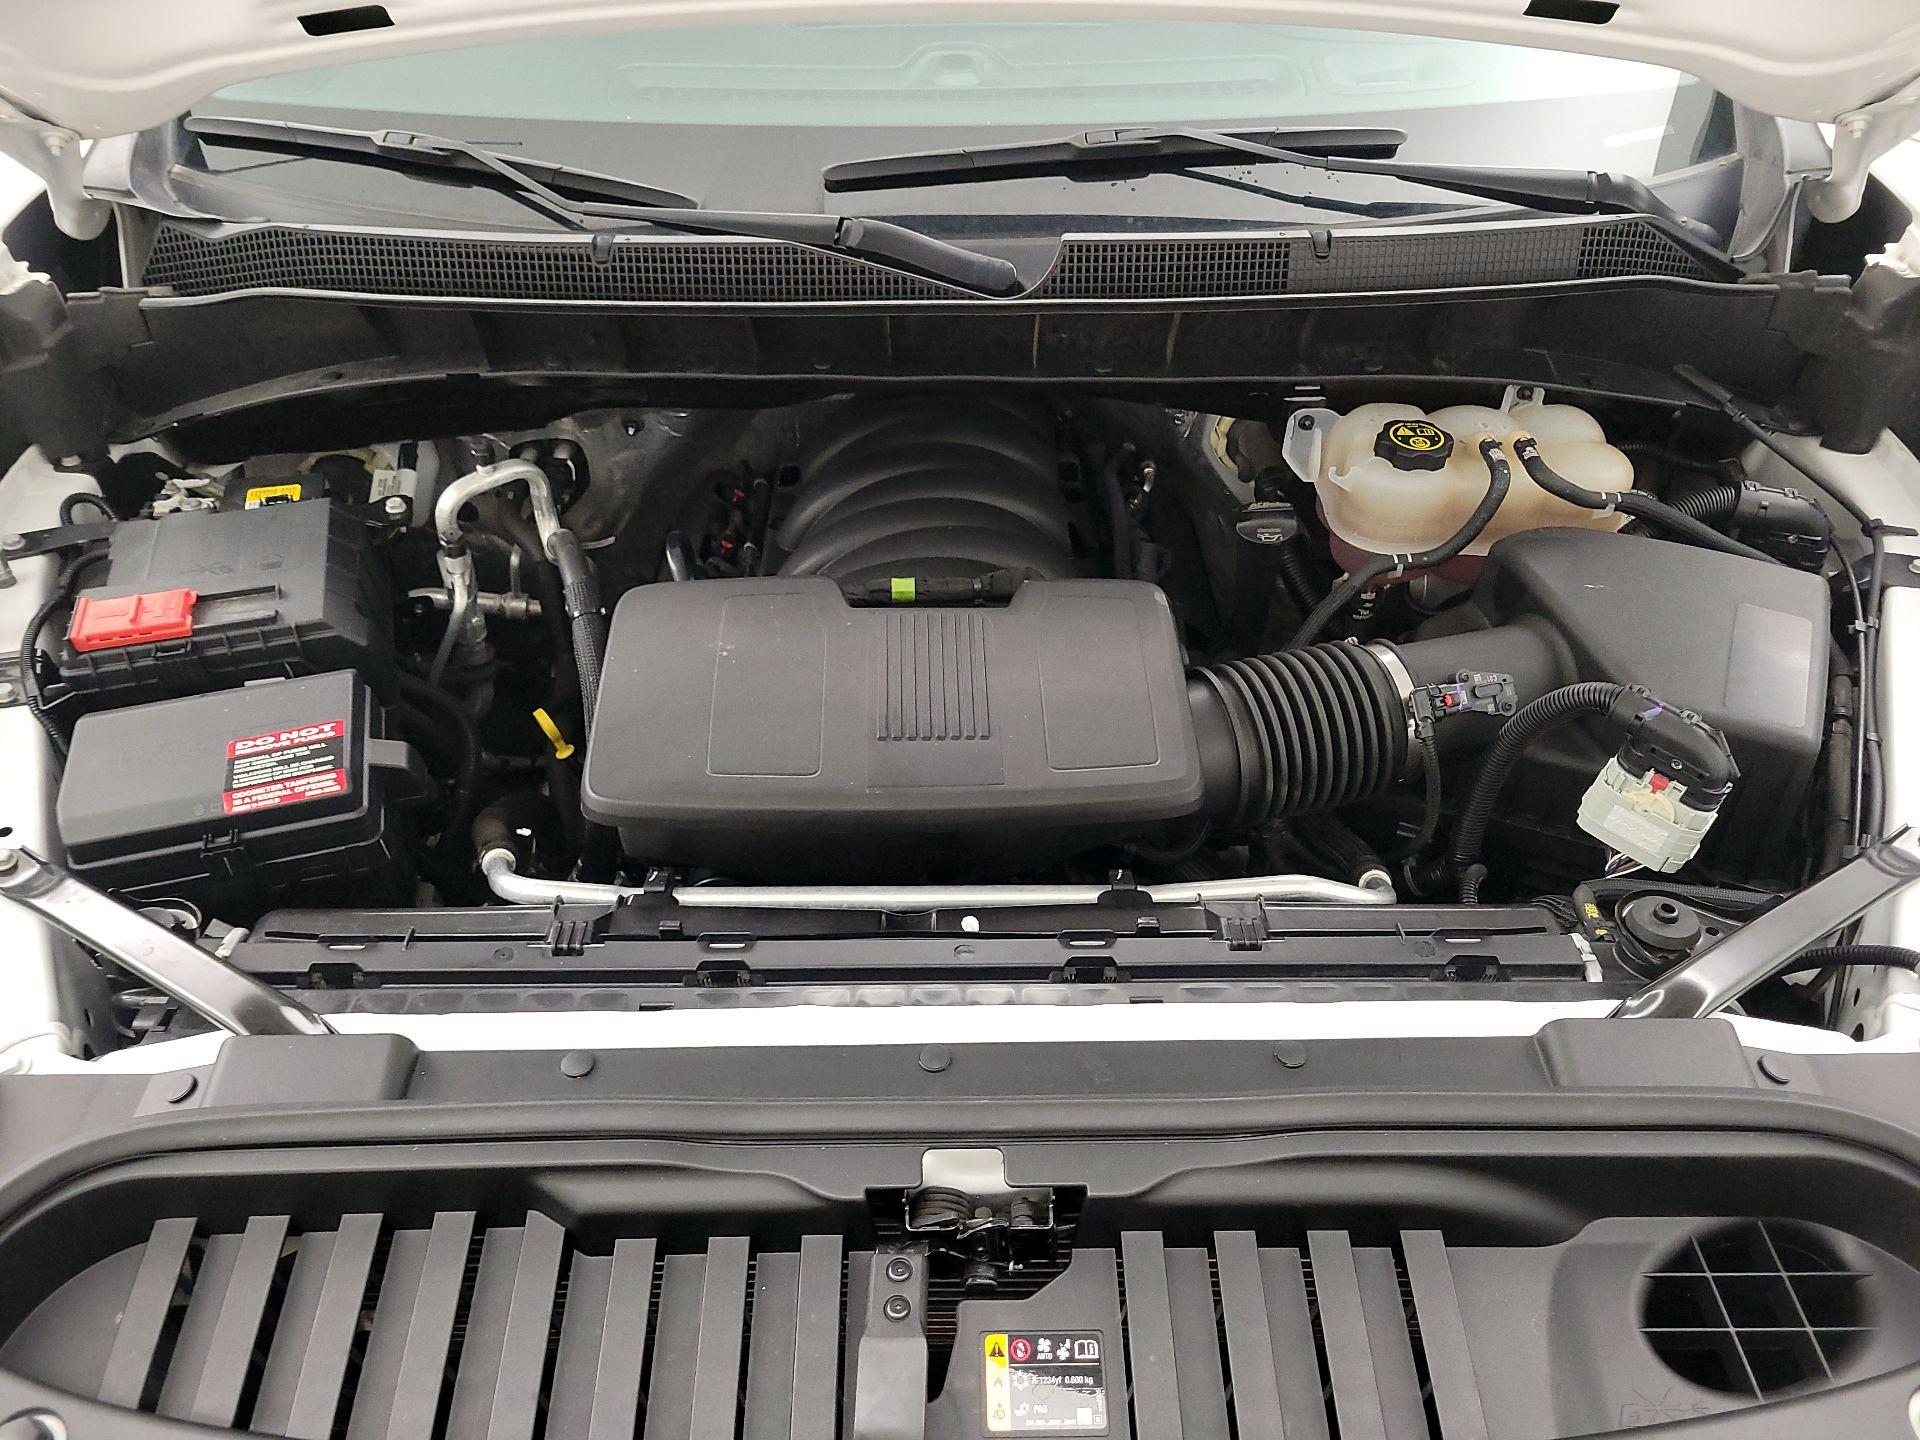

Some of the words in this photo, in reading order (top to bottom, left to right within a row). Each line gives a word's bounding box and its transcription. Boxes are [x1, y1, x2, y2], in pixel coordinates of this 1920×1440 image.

[235, 741, 290, 756] REMOVE
[294, 730, 335, 743] FUSES
[236, 736, 274, 750] DO
[280, 723, 336, 740] NOT
[232, 782, 283, 799] ODOMETER
[284, 771, 336, 788] TAMPERING
[232, 798, 242, 806] IS
[252, 787, 292, 802] FEDERAL
[1037, 1352, 1053, 1360] AUTO
[1064, 1375, 1083, 1384] 0.600
[1084, 1375, 1094, 1385] kg
